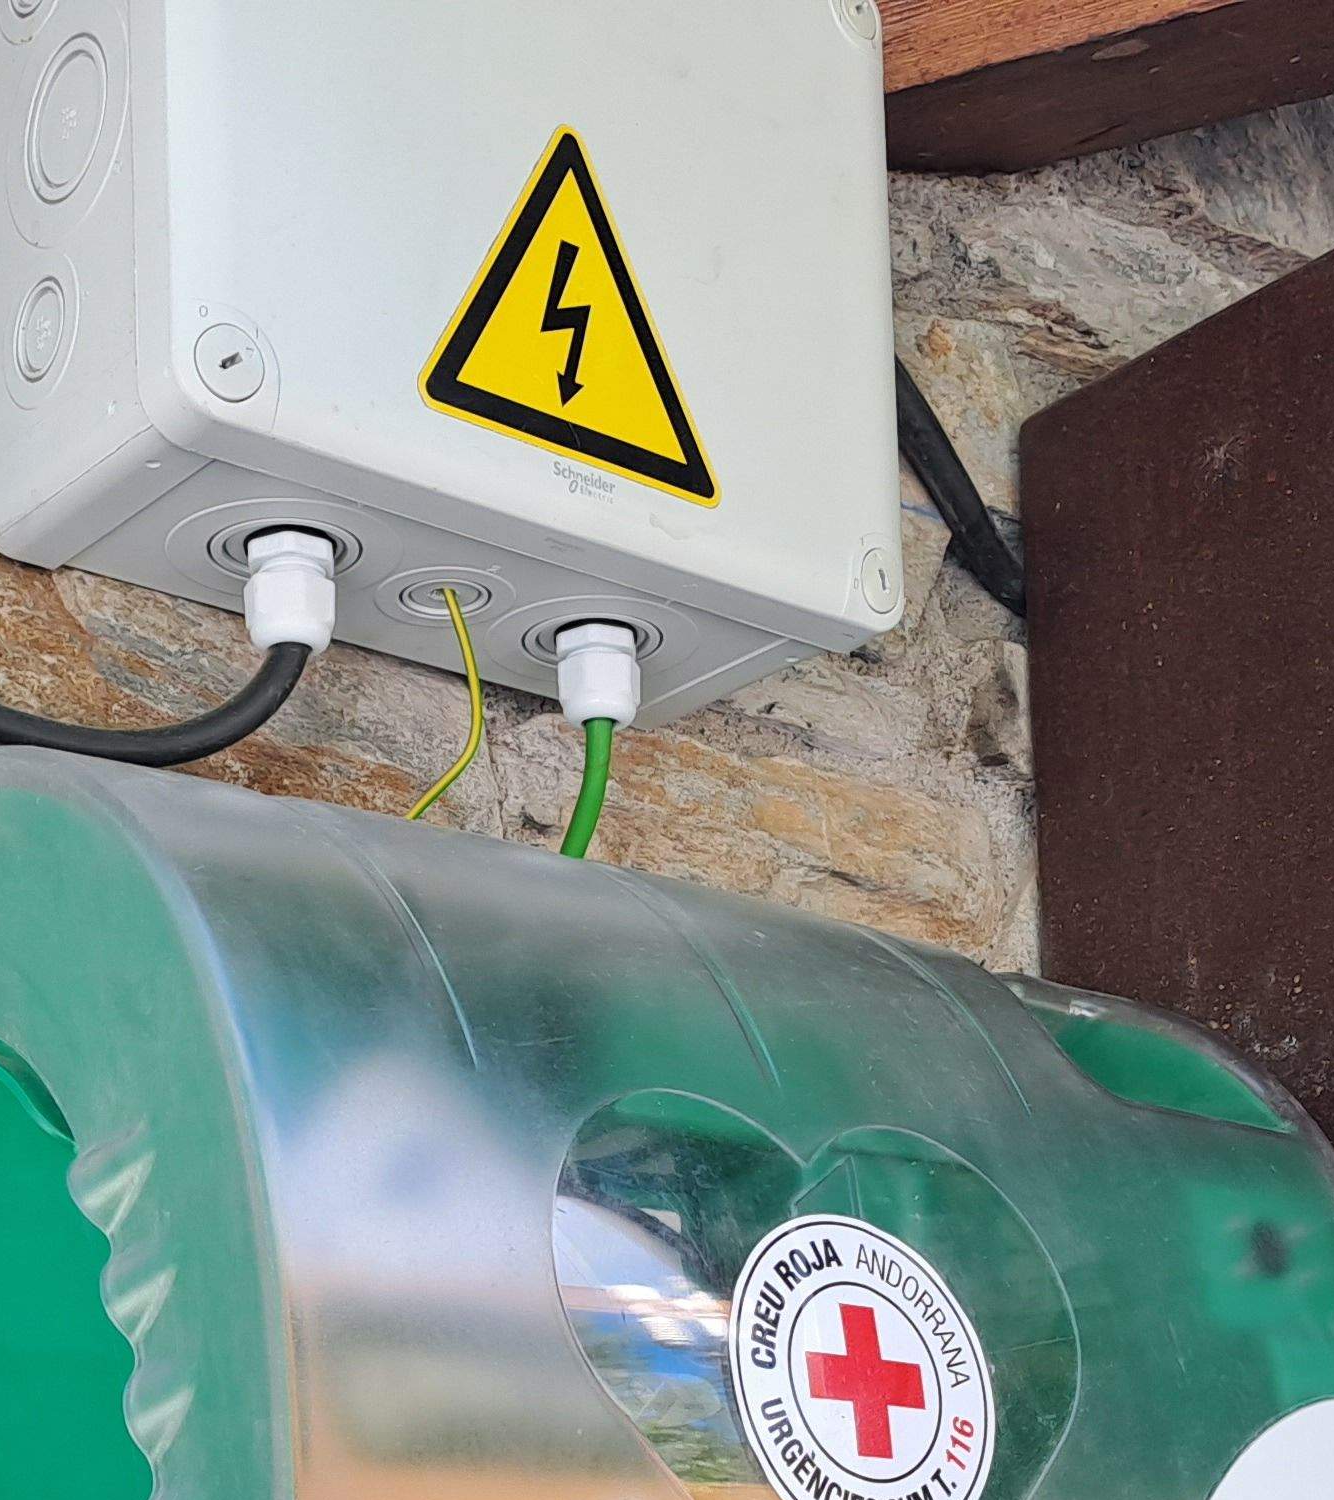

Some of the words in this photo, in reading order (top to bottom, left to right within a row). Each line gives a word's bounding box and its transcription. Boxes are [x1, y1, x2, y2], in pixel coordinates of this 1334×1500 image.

[553, 461, 615, 494] Schneider
[752, 1285, 786, 1370] CREU
[774, 1238, 843, 1291] ROJA
[855, 1243, 971, 1389] ANDORRANA
[932, 1468, 958, 1499] T.
[946, 1415, 976, 1471] 116
